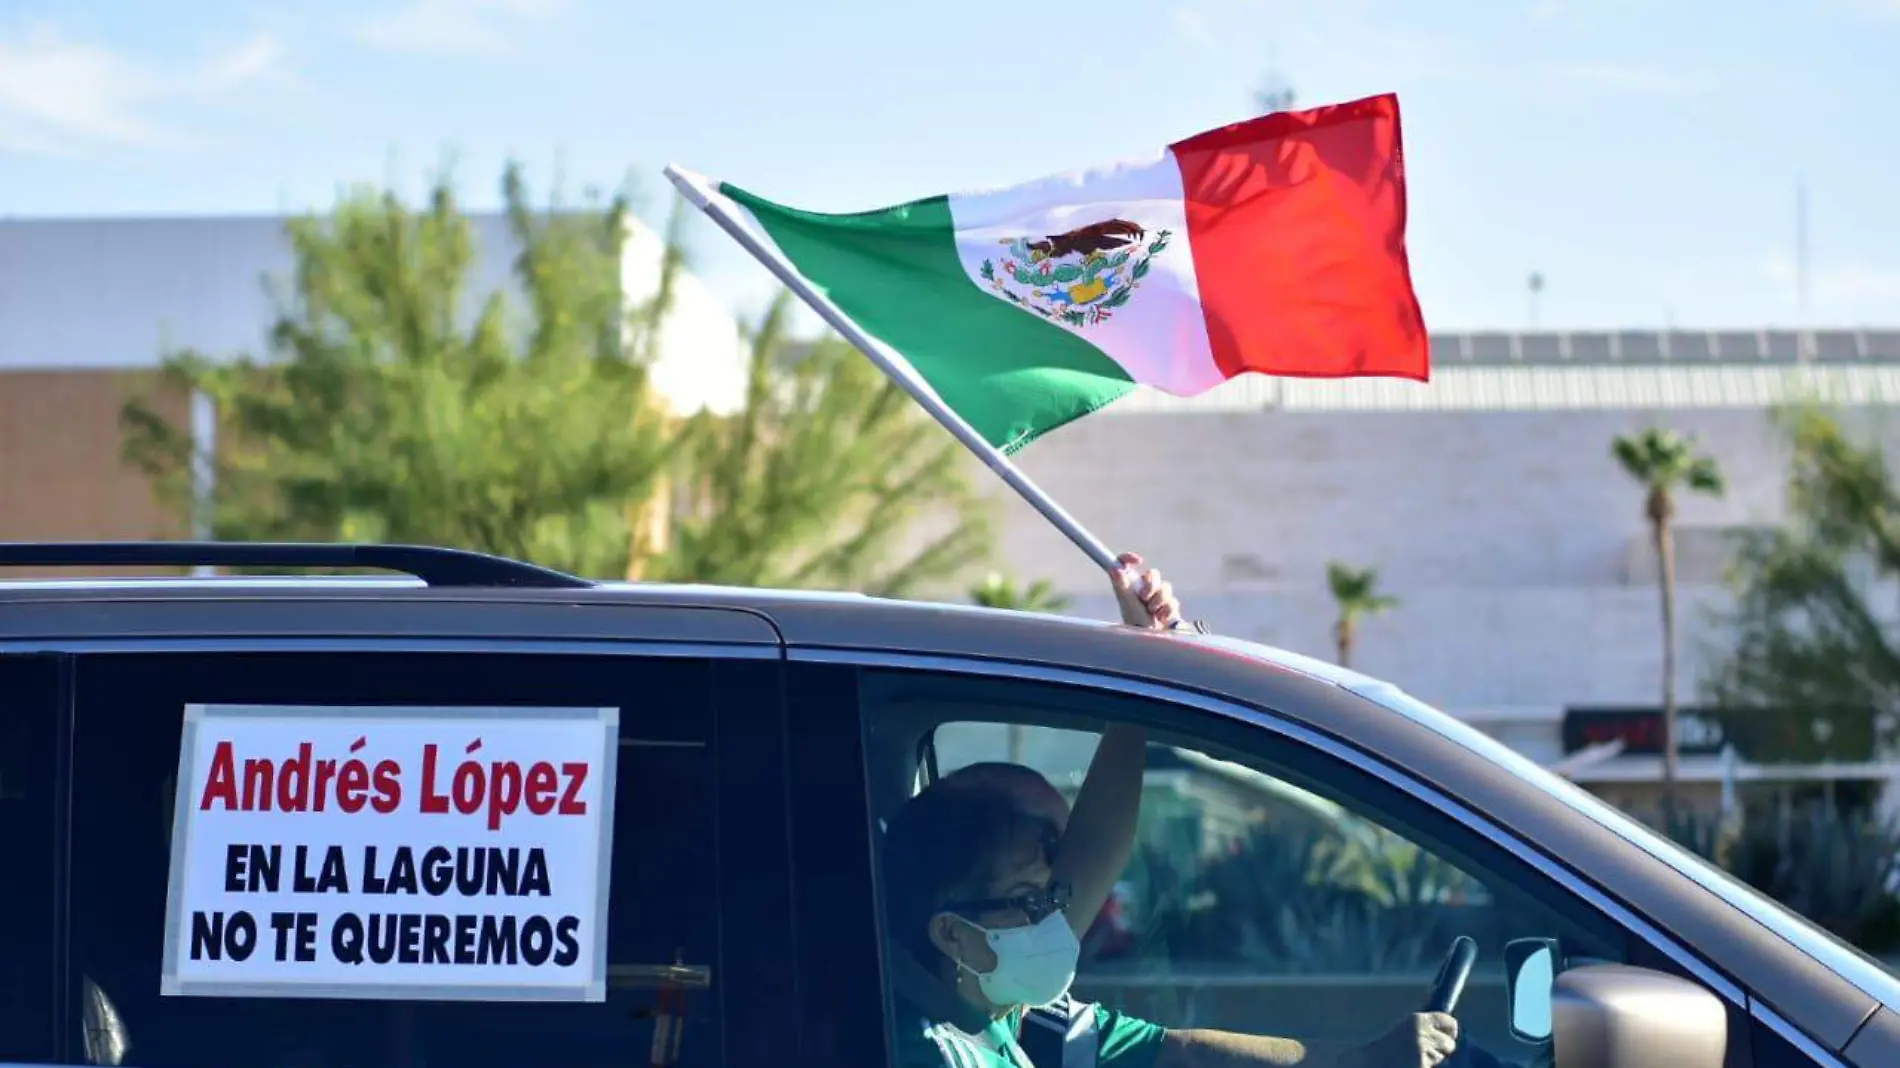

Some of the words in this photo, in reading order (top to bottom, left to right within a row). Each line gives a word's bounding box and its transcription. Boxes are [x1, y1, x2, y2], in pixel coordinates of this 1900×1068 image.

[200, 737, 401, 813] Andrés
[420, 739, 588, 830] López
[225, 844, 281, 892] EN
[293, 845, 349, 893] LA
[362, 846, 551, 896] LAGUNA
[191, 911, 257, 961] NO
[271, 912, 317, 961] TE
[331, 913, 579, 966] QUEREMOS
